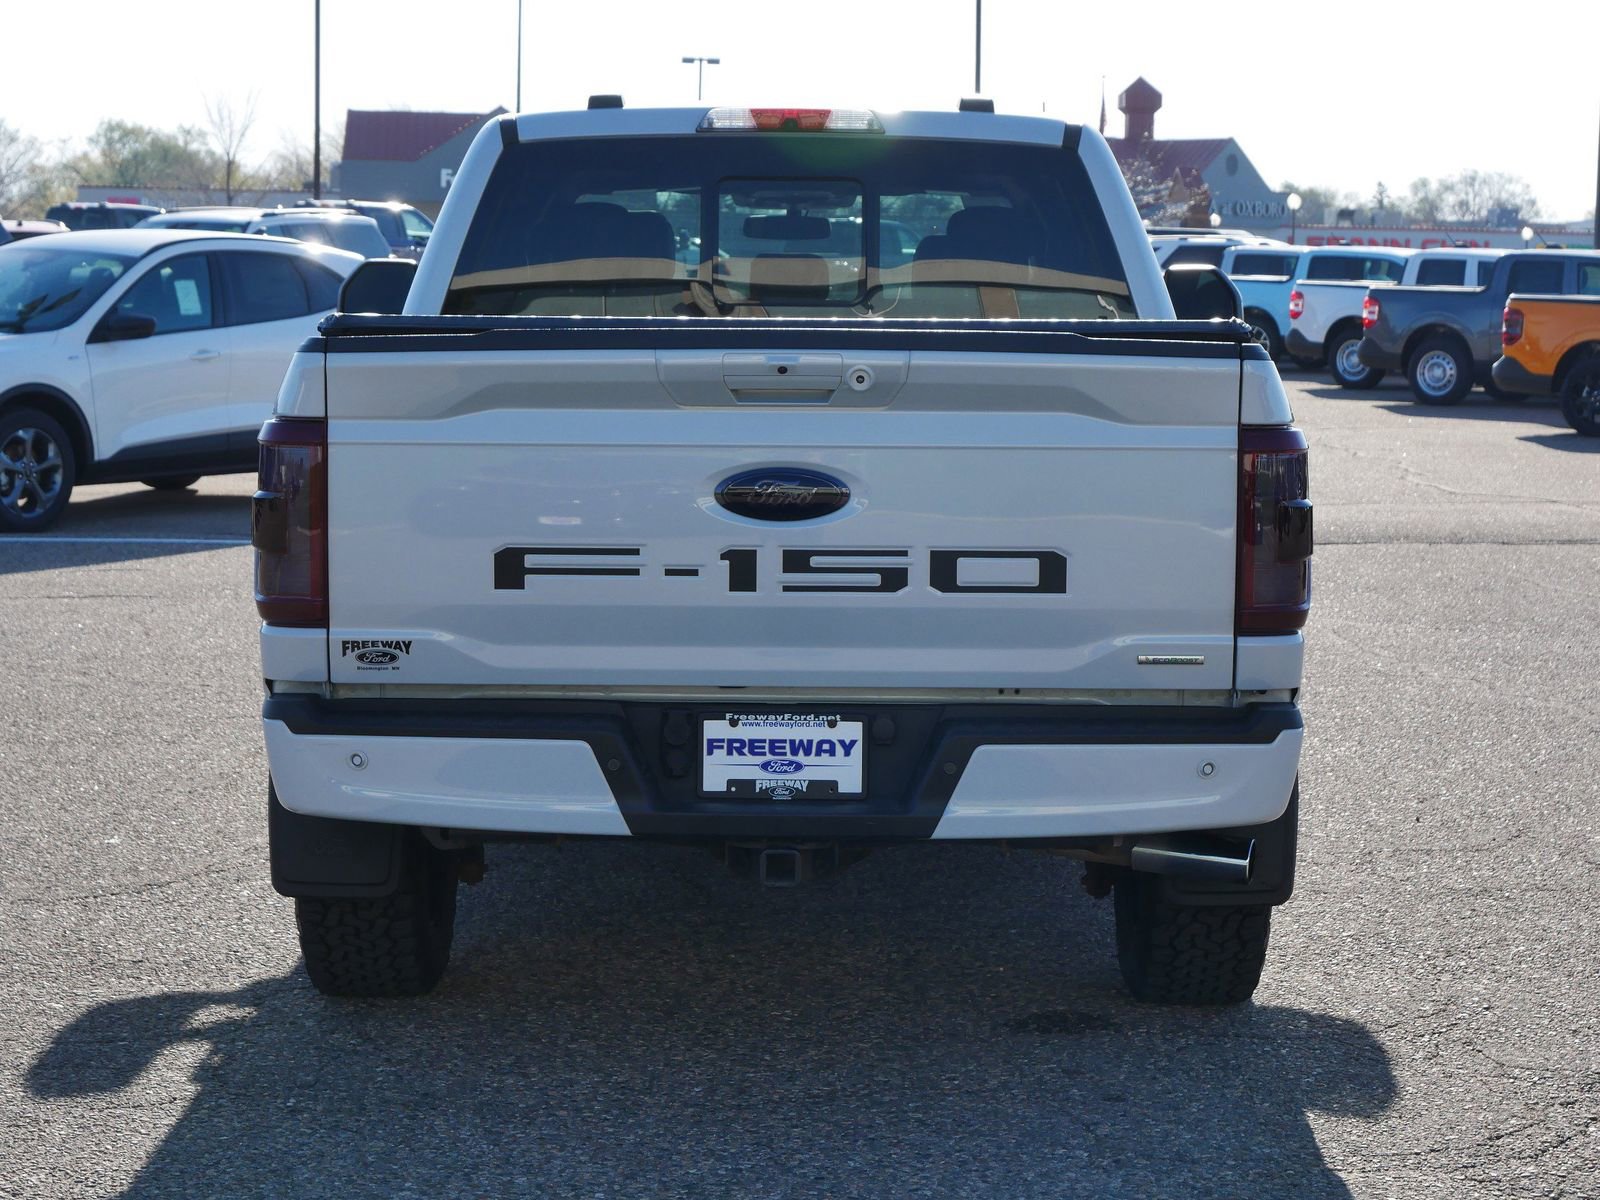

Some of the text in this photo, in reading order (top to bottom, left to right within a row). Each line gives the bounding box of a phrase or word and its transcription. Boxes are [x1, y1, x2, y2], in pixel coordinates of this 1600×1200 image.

[745, 480, 818, 505] Ford
[493, 544, 1067, 594] F-150
[341, 640, 413, 658] FREEWAY
[363, 651, 391, 662] Ford
[725, 713, 841, 722] FreewayFord.net
[741, 720, 826, 729] www.freewayford.net
[706, 738, 858, 757] FREEWAY
[767, 760, 797, 773] Ford
[755, 779, 809, 793] FREEWAY
[773, 787, 790, 795] Ford
